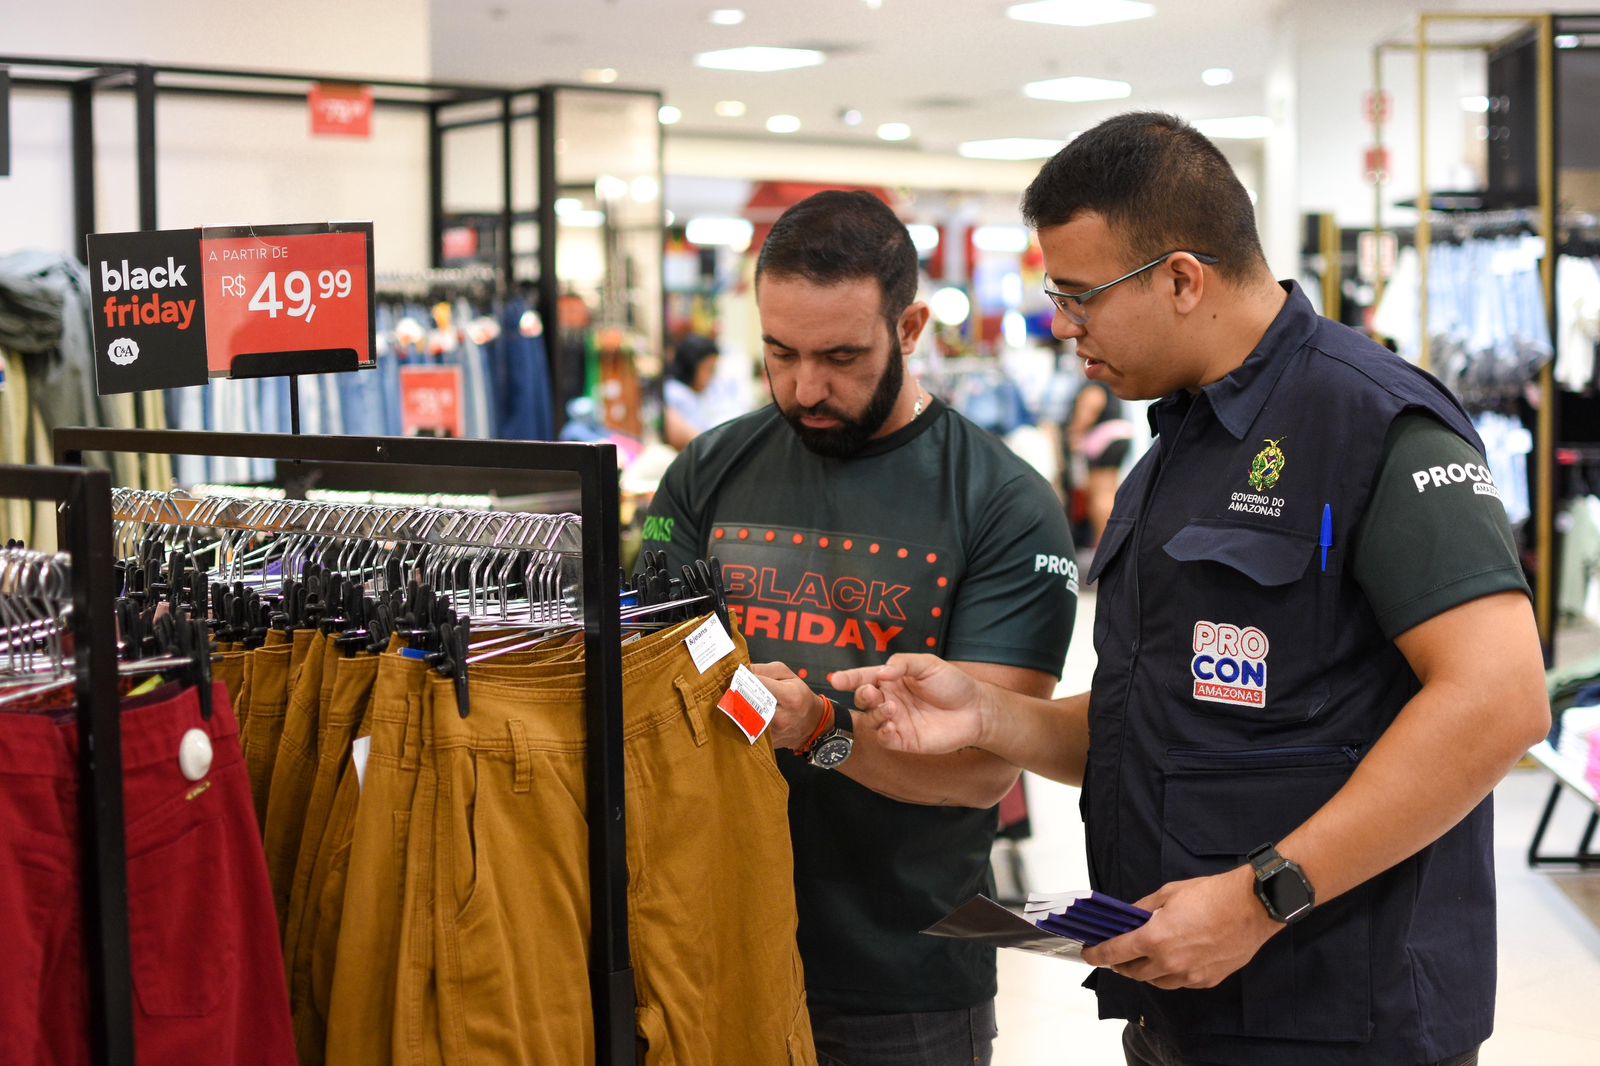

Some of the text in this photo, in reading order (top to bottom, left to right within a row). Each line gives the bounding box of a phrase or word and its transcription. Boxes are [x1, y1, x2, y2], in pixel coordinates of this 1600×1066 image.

[208, 246, 289, 262] A PARTIR DE
[100, 256, 188, 292] black
[221, 273, 247, 298] R$
[103, 293, 198, 331] friday
[113, 344, 134, 358] C&A
[1412, 462, 1494, 493] PROCO
[1228, 501, 1281, 517] AMAZONAS
[1231, 491, 1285, 508] GOVERNO DO
[721, 564, 911, 621] BLACK
[689, 627, 708, 645] &jeans
[1194, 623, 1266, 660] PRO
[1193, 655, 1264, 687] CON
[1198, 685, 1260, 701] AMAZONAS
